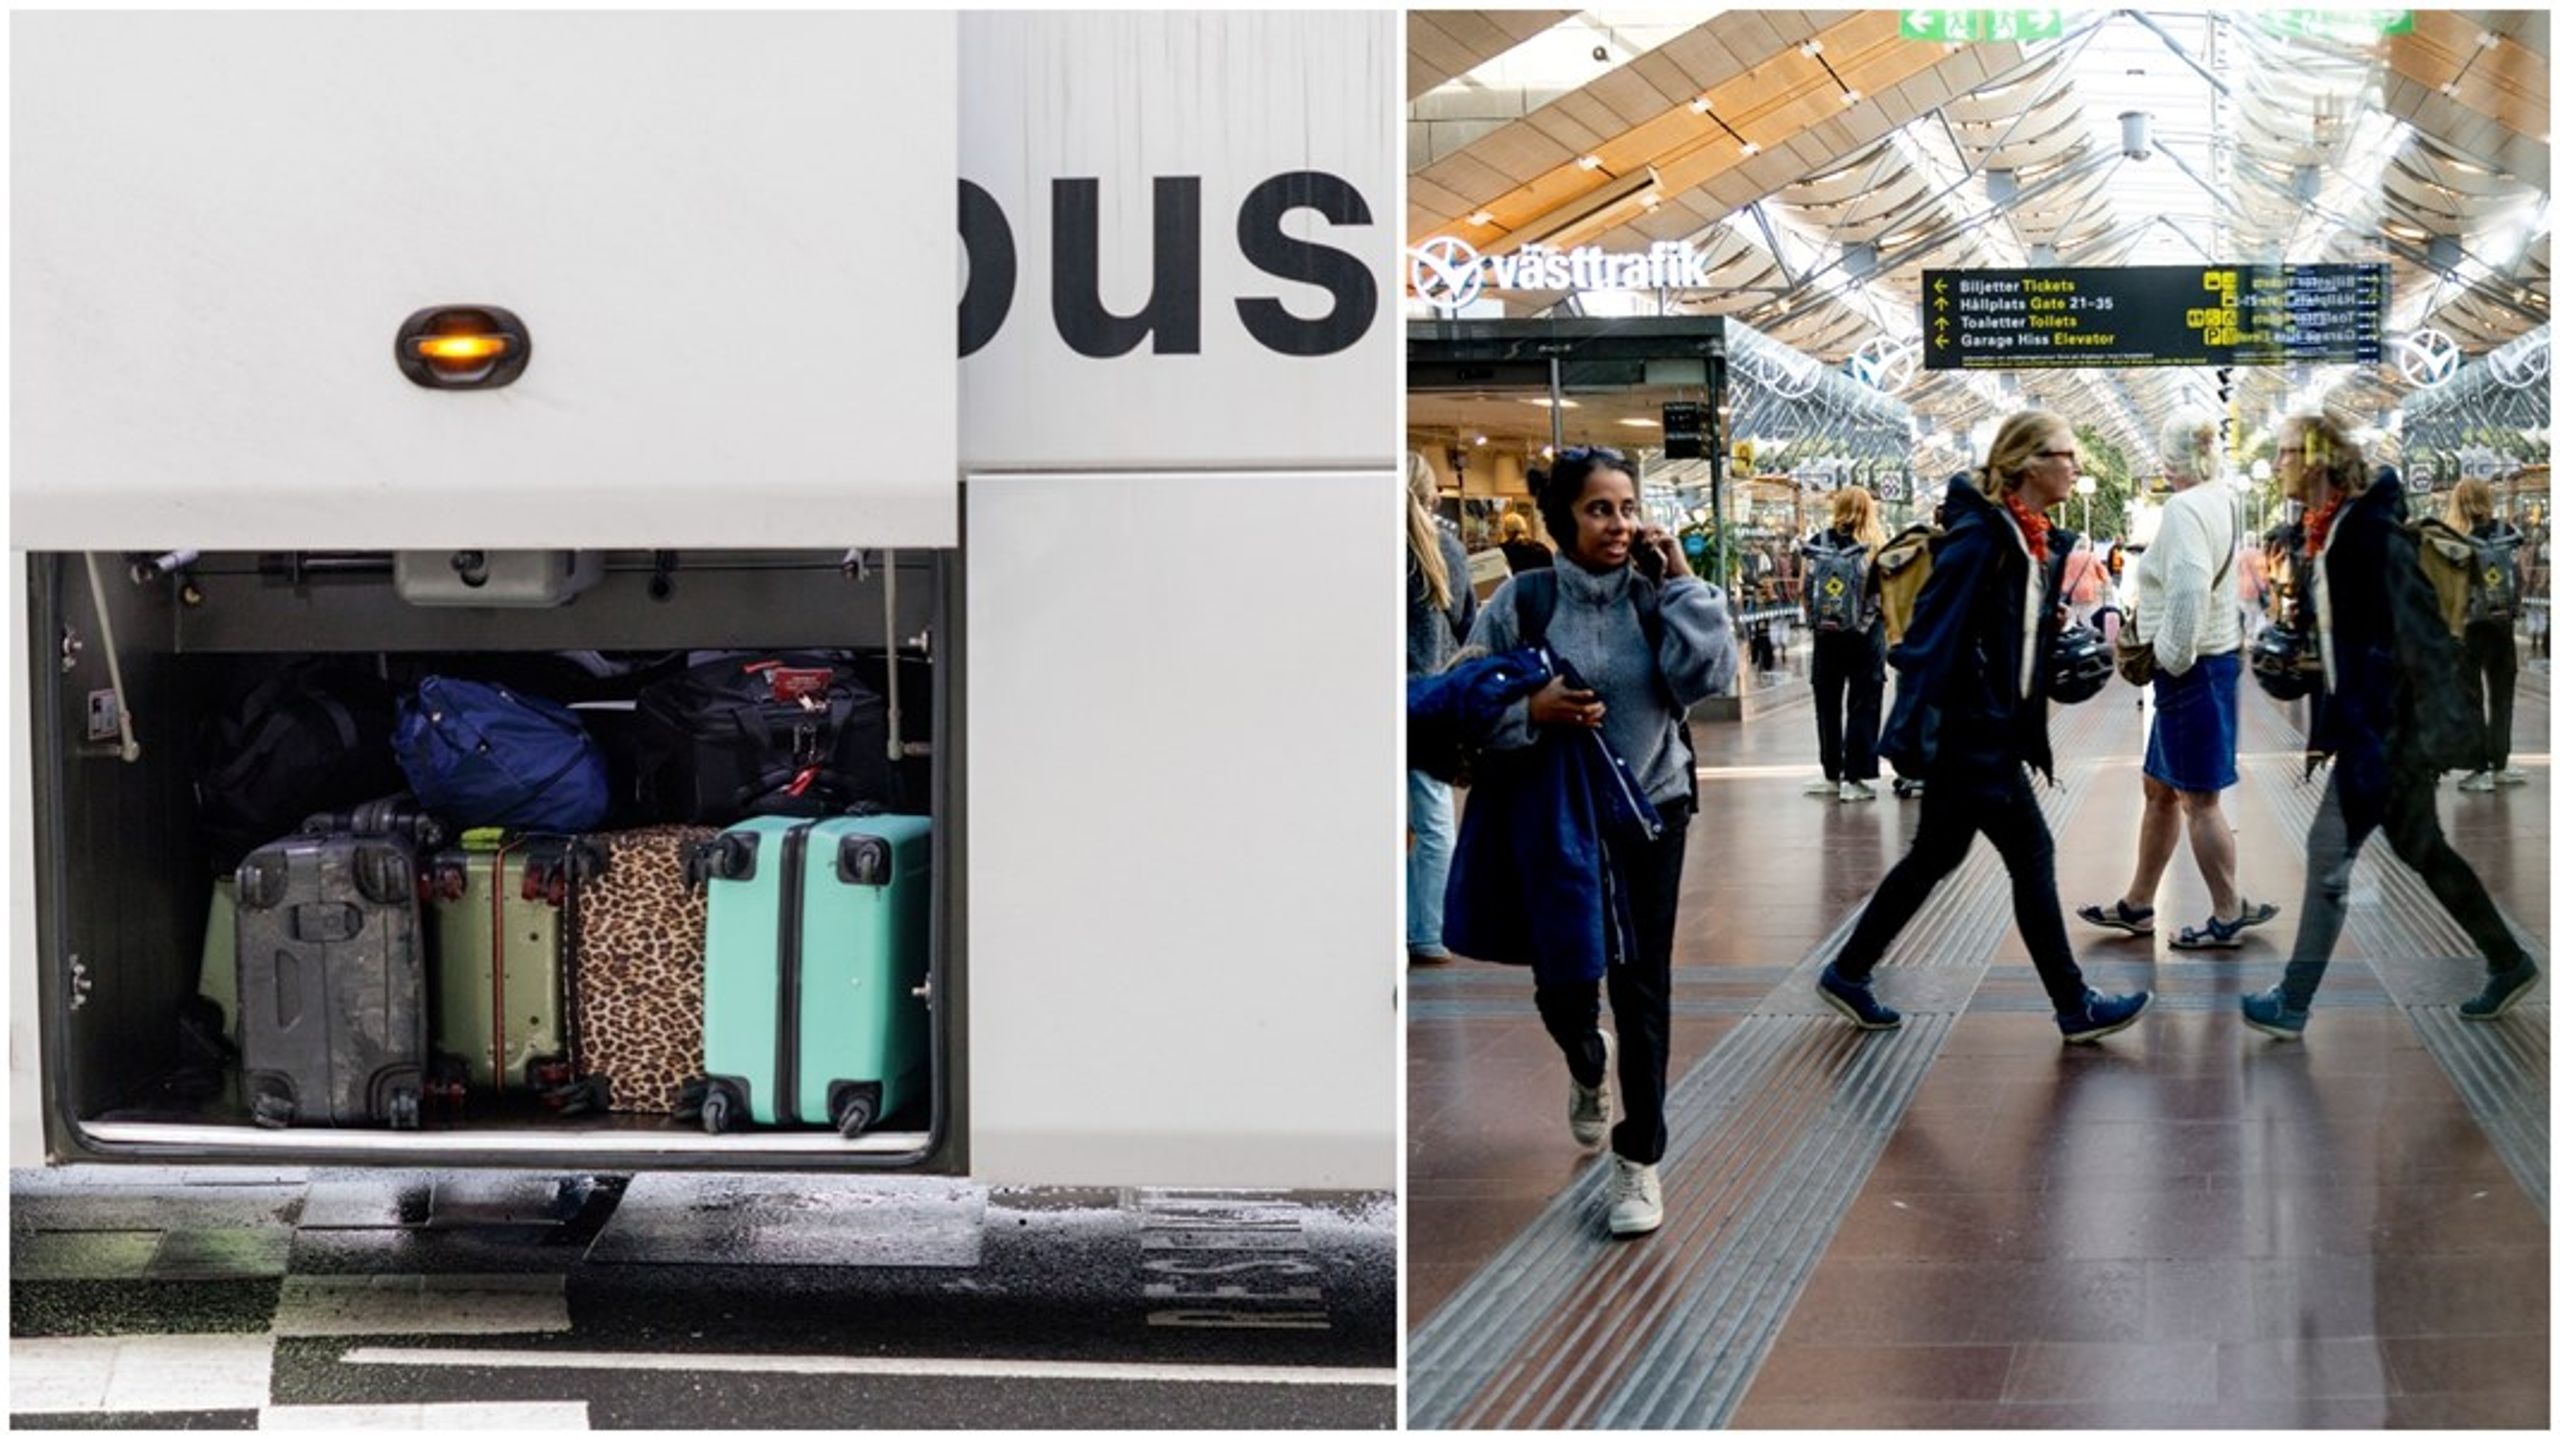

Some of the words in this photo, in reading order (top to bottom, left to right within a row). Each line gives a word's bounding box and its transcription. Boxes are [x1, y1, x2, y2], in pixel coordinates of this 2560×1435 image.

[1488, 240, 1711, 290] västtrafik
[1959, 279, 2020, 295] Biljetter
[2021, 278, 2076, 293] Tickets
[1959, 297, 2027, 313] Hållplats
[2029, 297, 2066, 311] Gate
[1960, 315, 2027, 330] Toaletter
[2027, 314, 2078, 328] Toilets
[1960, 333, 2014, 349] Garage
[2017, 333, 2050, 346] Hiss
[2053, 331, 2116, 346] Elevator
